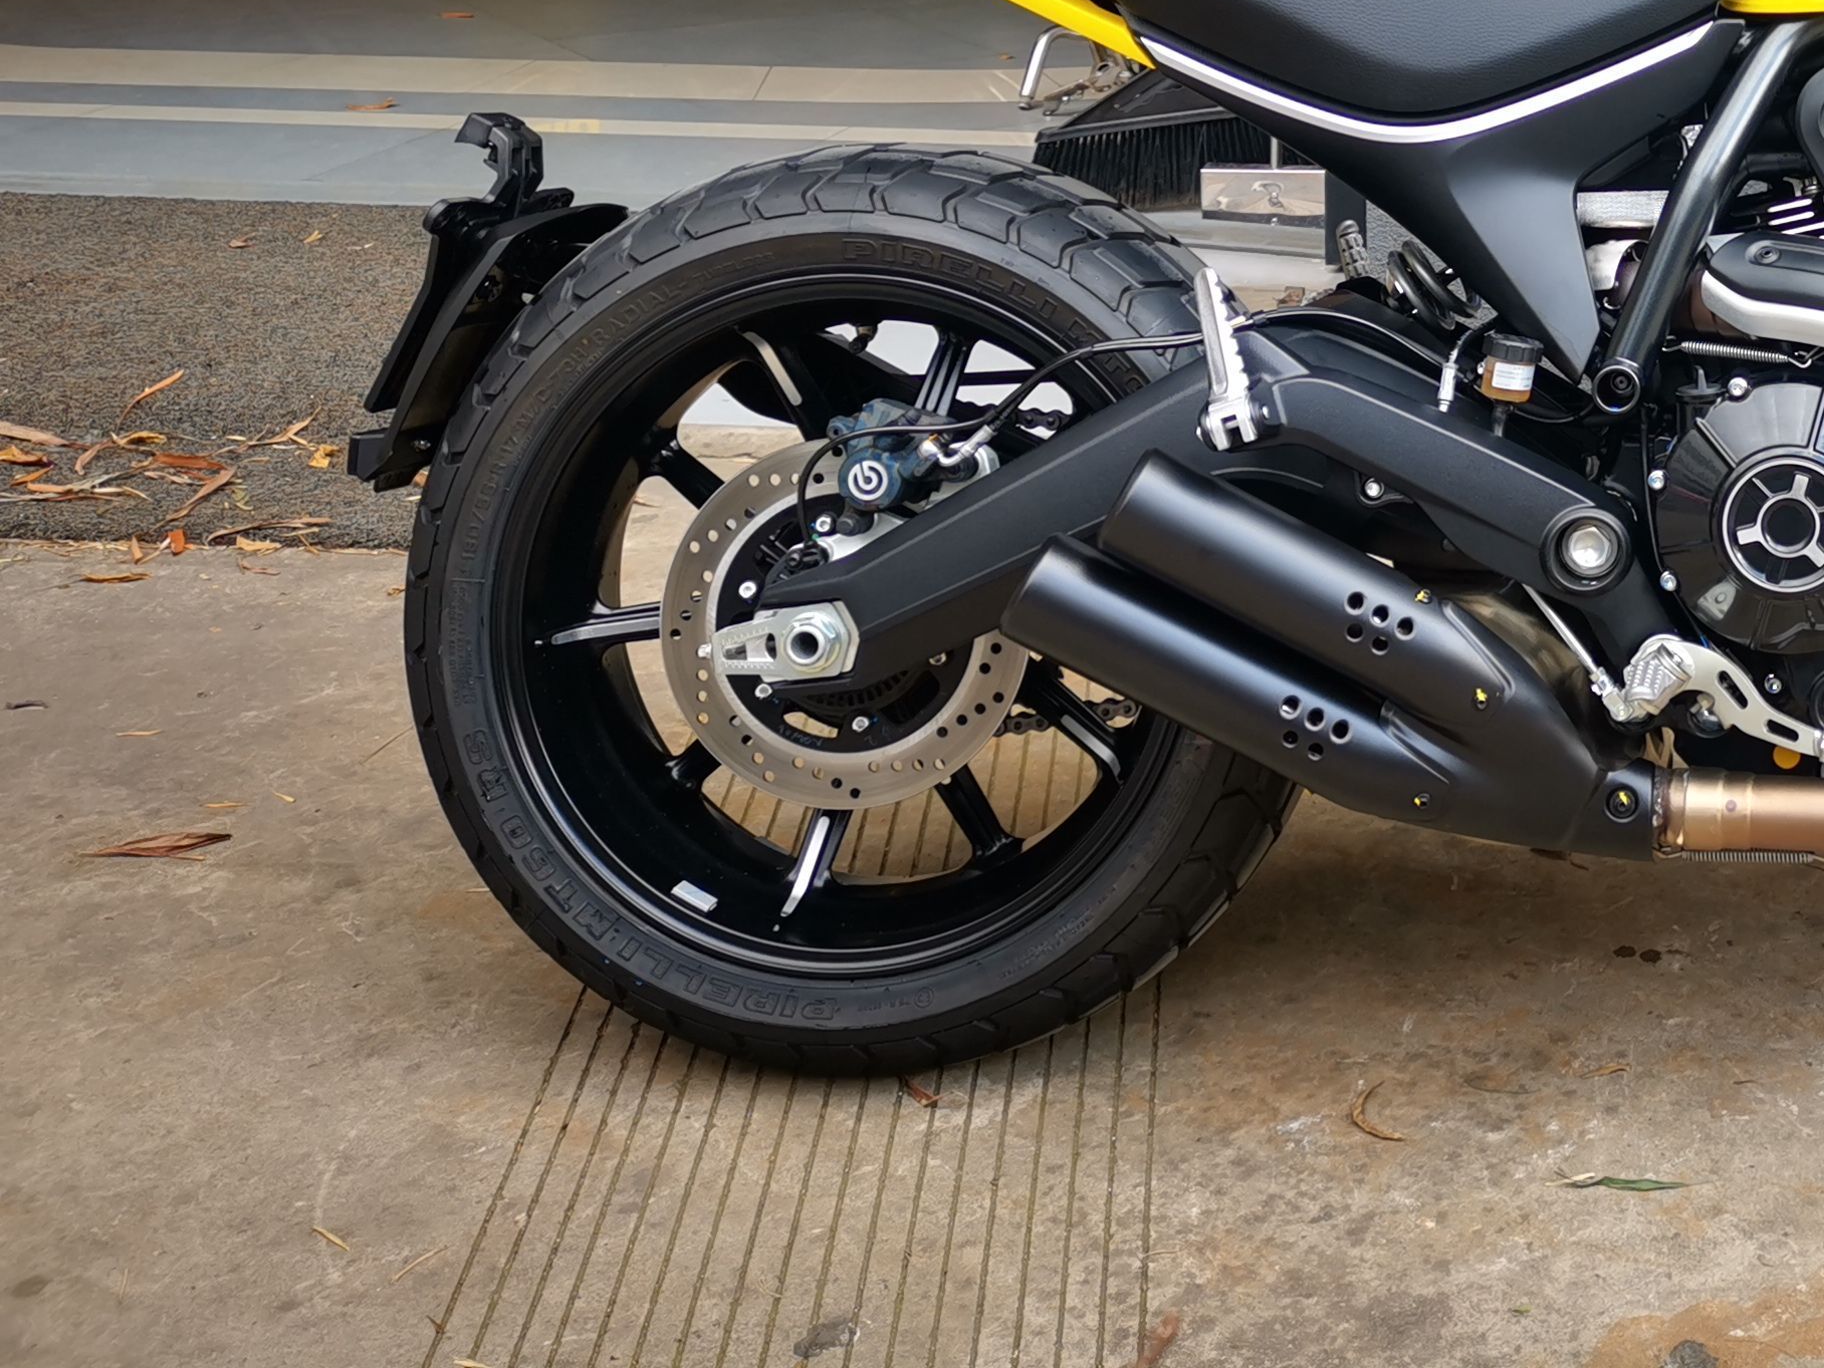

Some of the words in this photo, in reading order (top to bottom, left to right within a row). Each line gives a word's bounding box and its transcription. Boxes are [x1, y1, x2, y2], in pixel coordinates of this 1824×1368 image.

[843, 238, 1060, 318] PIRELLI
[463, 728, 507, 802] RS
[611, 936, 843, 1020] PIRELLI
